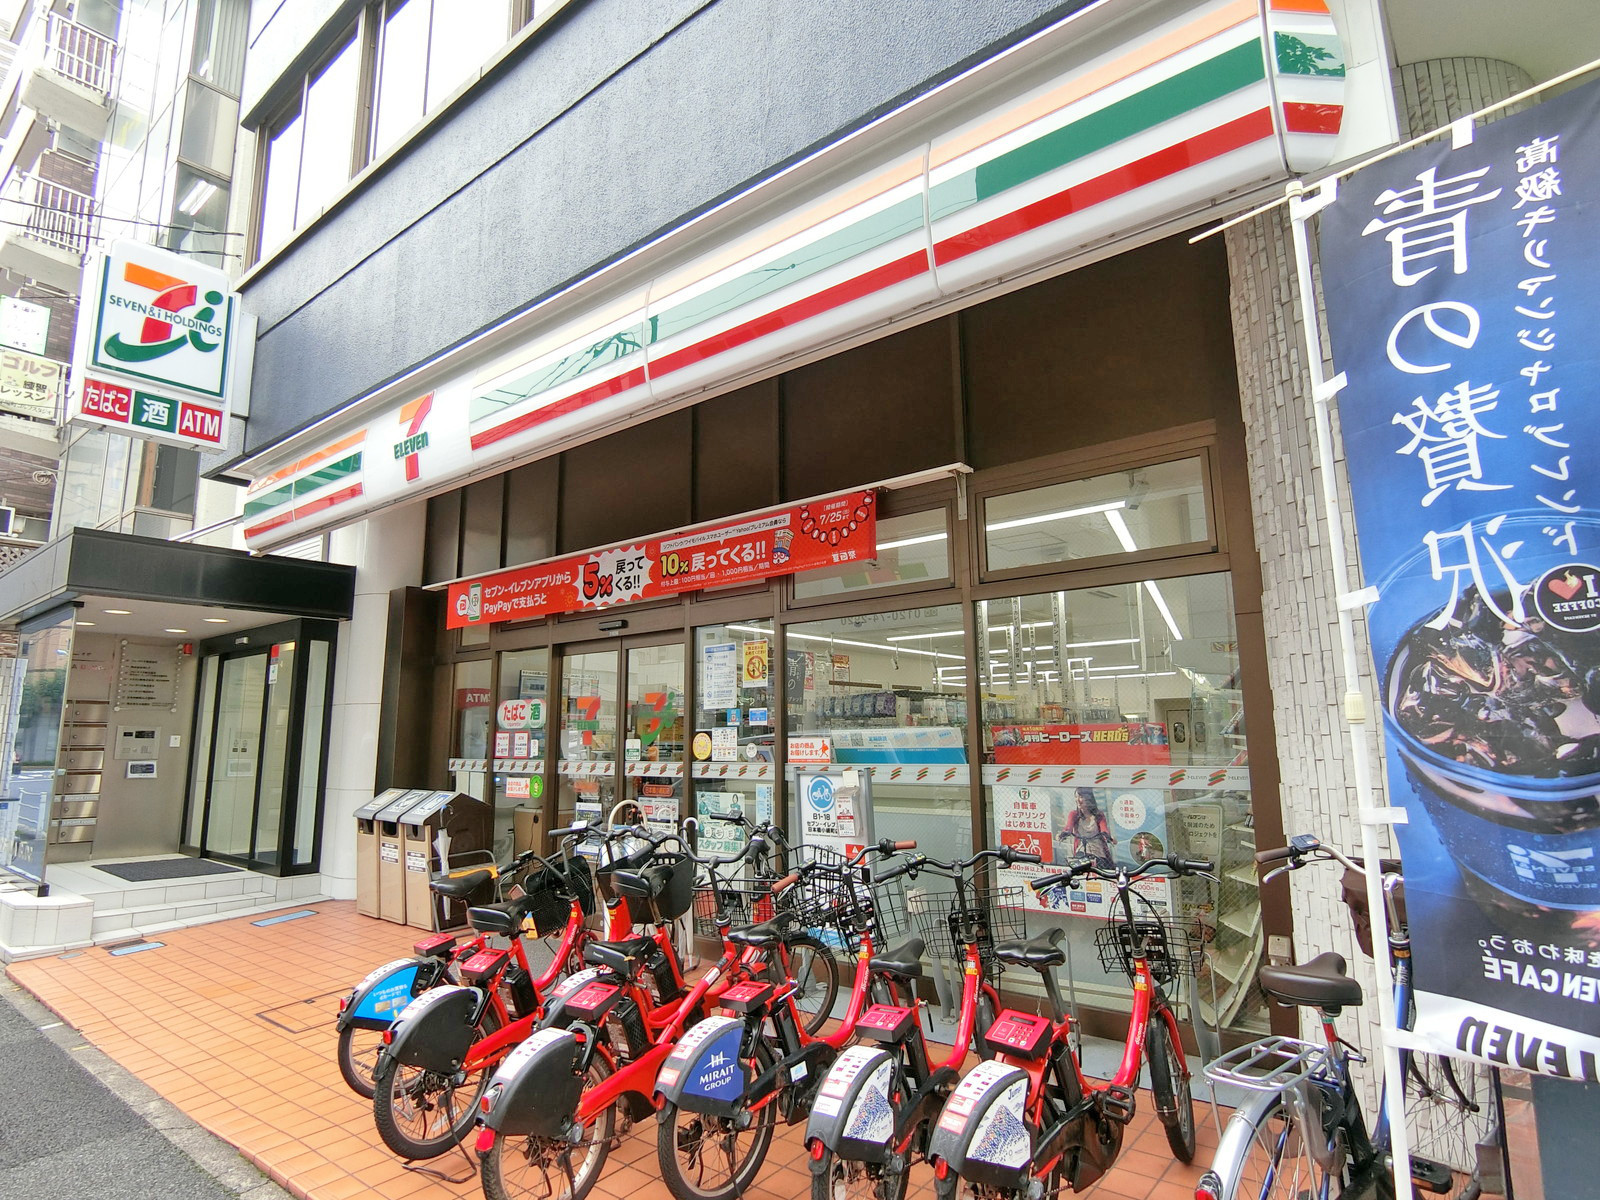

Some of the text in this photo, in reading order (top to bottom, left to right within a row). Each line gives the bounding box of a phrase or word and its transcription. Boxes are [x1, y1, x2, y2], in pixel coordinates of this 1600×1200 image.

[164, 310, 222, 338] HOLDINGS
[2, 354, 58, 378] ゴルフ
[83, 385, 220, 438] たばこ 酒 ATM
[819, 511, 842, 525] 7/25
[661, 552, 688, 577] 10%
[583, 555, 644, 600] 5% 戻って
[484, 592, 548, 614] PayPayで支払うと
[503, 703, 541, 721] たばこ 酒
[1005, 811, 1046, 820] シェアリング
[1013, 801, 1037, 810] 自転車
[1005, 820, 1047, 829] はじめました
[700, 1063, 735, 1085] MIRAIT
[704, 1076, 732, 1091] GROUP
